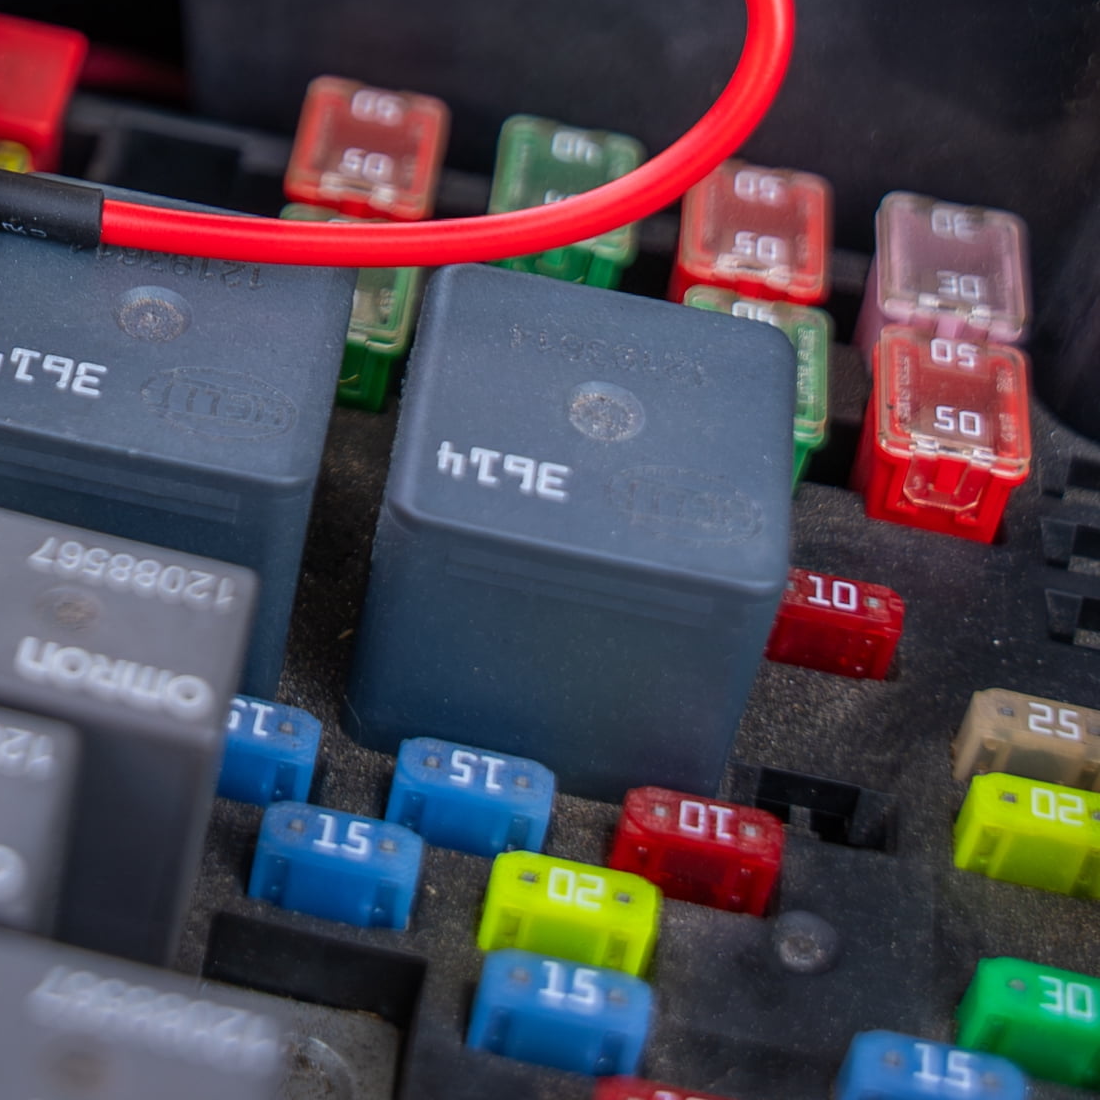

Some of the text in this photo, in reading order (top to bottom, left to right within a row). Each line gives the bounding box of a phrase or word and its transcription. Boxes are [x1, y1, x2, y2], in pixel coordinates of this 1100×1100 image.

[734, 170, 788, 205] 50
[733, 231, 788, 266] 50
[936, 270, 981, 299] 30
[930, 337, 979, 369] 50
[934, 405, 982, 436] 50
[437, 440, 572, 501] 3614
[27, 536, 236, 613] 12088567
[807, 575, 857, 611] 10
[1027, 702, 1082, 742] 25
[449, 750, 506, 790] 15
[678, 800, 733, 839] 10
[1030, 786, 1085, 827] 20
[312, 813, 372, 856] 15
[547, 866, 606, 910] 20
[539, 960, 600, 1007] 15
[1038, 975, 1094, 1021] 30
[912, 1042, 974, 1091] 15
